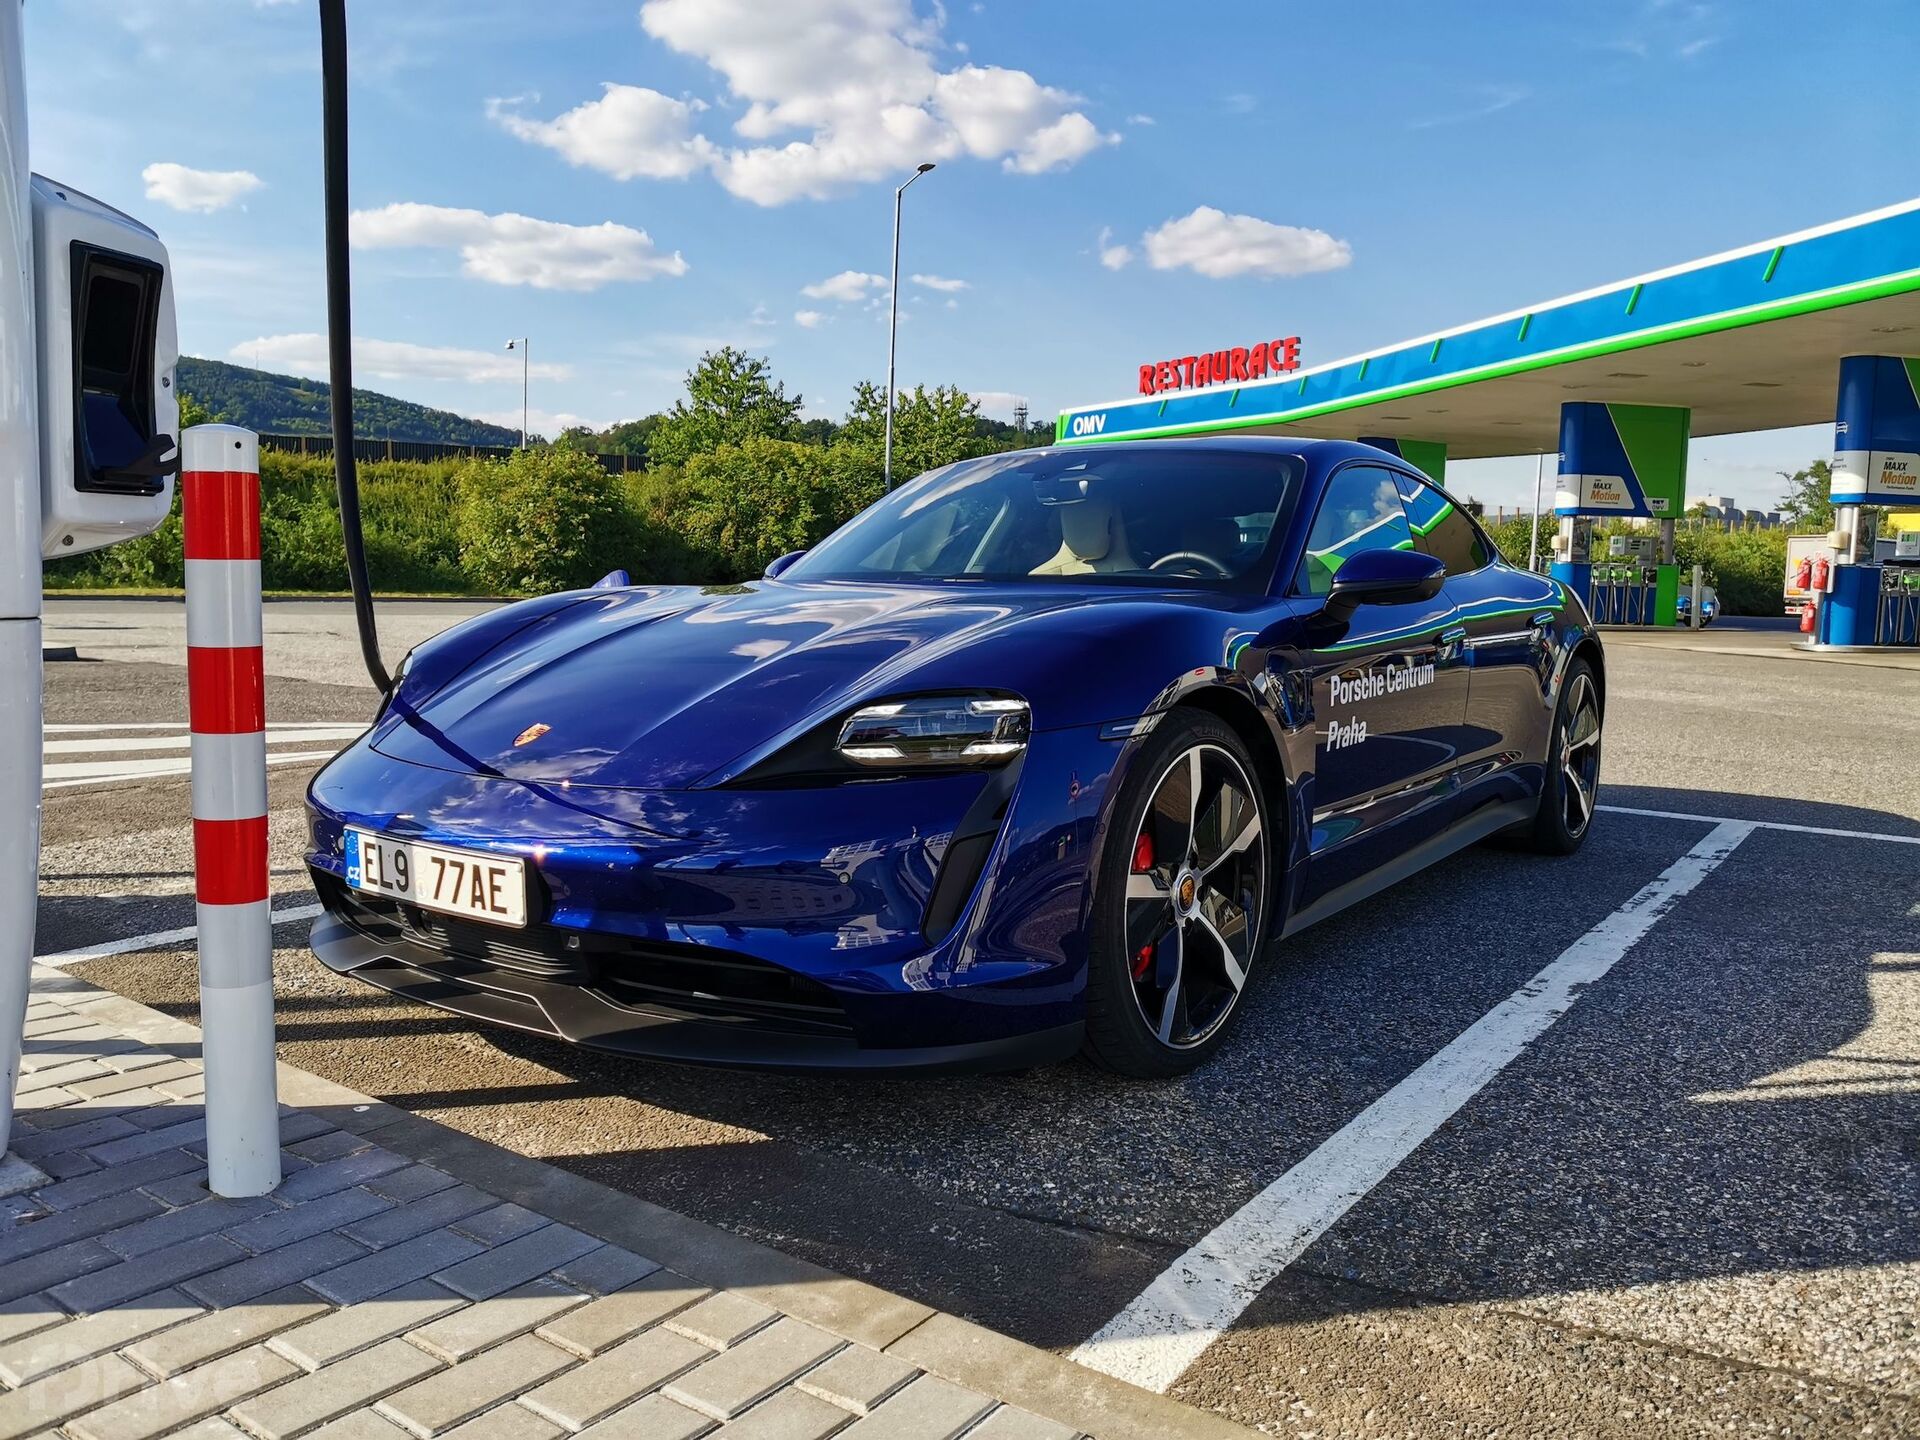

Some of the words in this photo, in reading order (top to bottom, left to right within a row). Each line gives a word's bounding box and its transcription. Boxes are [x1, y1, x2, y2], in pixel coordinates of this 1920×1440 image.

[1138, 336, 1301, 396] RESTAURACE
[1073, 413, 1107, 436] OMV
[1883, 461, 1908, 471] MAXX
[1592, 482, 1613, 490] MAXX
[1880, 471, 1917, 486] Motion
[1590, 490, 1621, 501] Motion
[1330, 668, 1385, 707] Porsche
[1386, 663, 1435, 694] Centrum
[1326, 715, 1367, 752] Praha
[347, 866, 360, 880] CZ
[363, 841, 410, 893] EL9
[430, 856, 508, 914] 77AE
